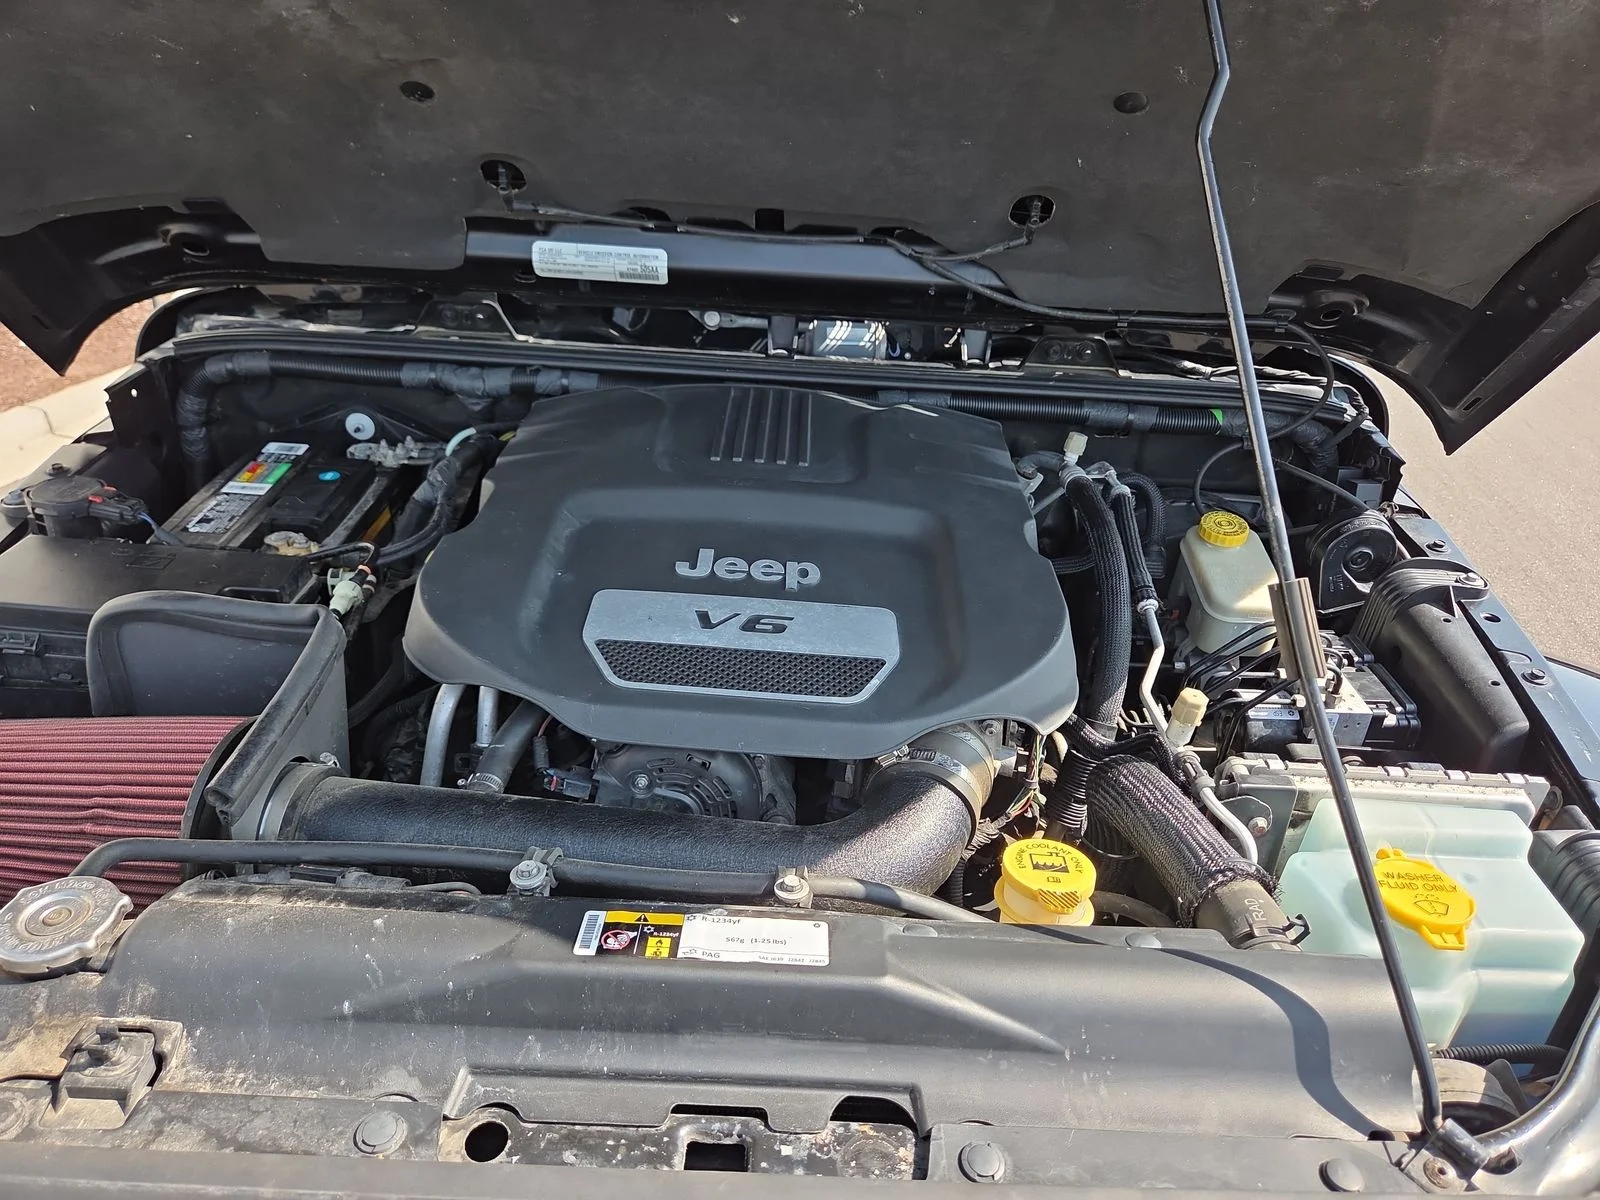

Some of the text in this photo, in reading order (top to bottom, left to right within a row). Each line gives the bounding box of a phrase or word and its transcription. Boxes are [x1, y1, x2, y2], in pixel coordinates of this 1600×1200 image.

[674, 547, 821, 592] Jeep
[695, 609, 795, 635] V6
[1015, 848, 1027, 870] ENGINE
[1026, 843, 1072, 856] COOLANT
[1383, 871, 1444, 882] WASHER
[1379, 880, 1458, 893] FLUID ONLY
[1244, 898, 1267, 921] RAD
[701, 914, 741, 925] R-1234yf
[750, 937, 771, 945] (1.25
[772, 938, 787, 946] lbs)
[701, 951, 721, 959] PAG
